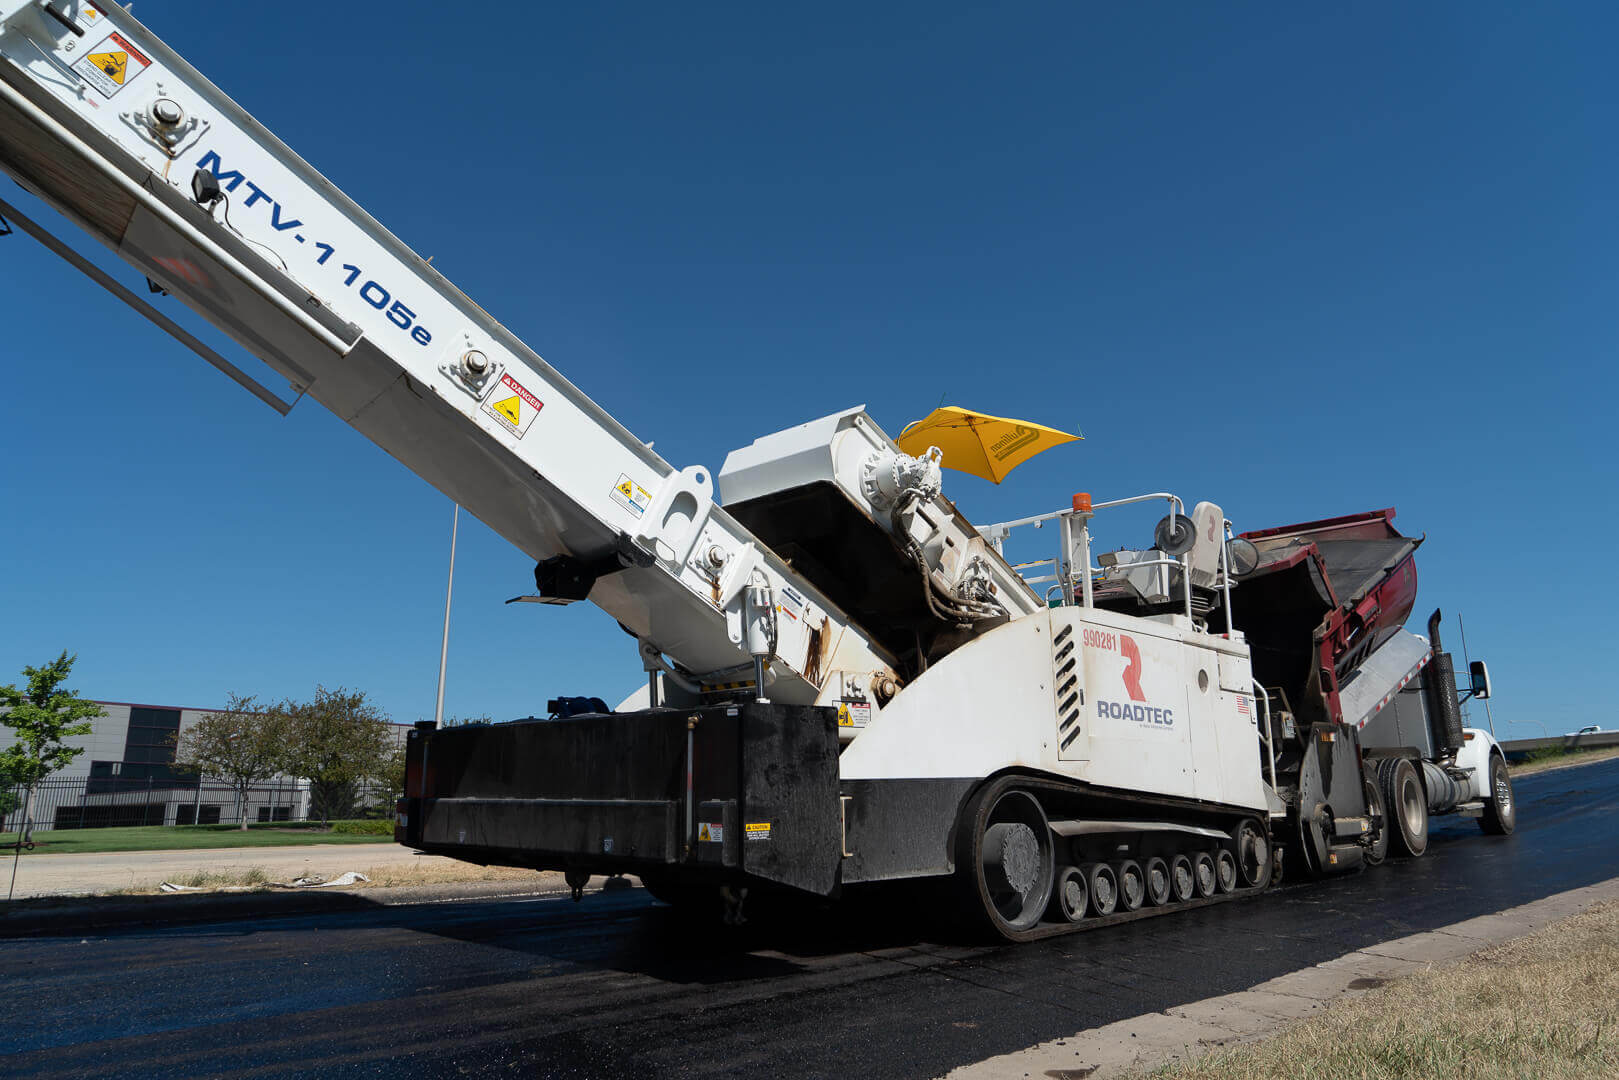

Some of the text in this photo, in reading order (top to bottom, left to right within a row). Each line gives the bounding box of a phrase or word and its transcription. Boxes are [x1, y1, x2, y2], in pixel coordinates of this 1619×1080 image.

[196, 150, 432, 346] MTV-1105e
[510, 382, 541, 409] DANGER
[1083, 628, 1117, 651] 990281
[1097, 701, 1174, 725] ROADTEC
